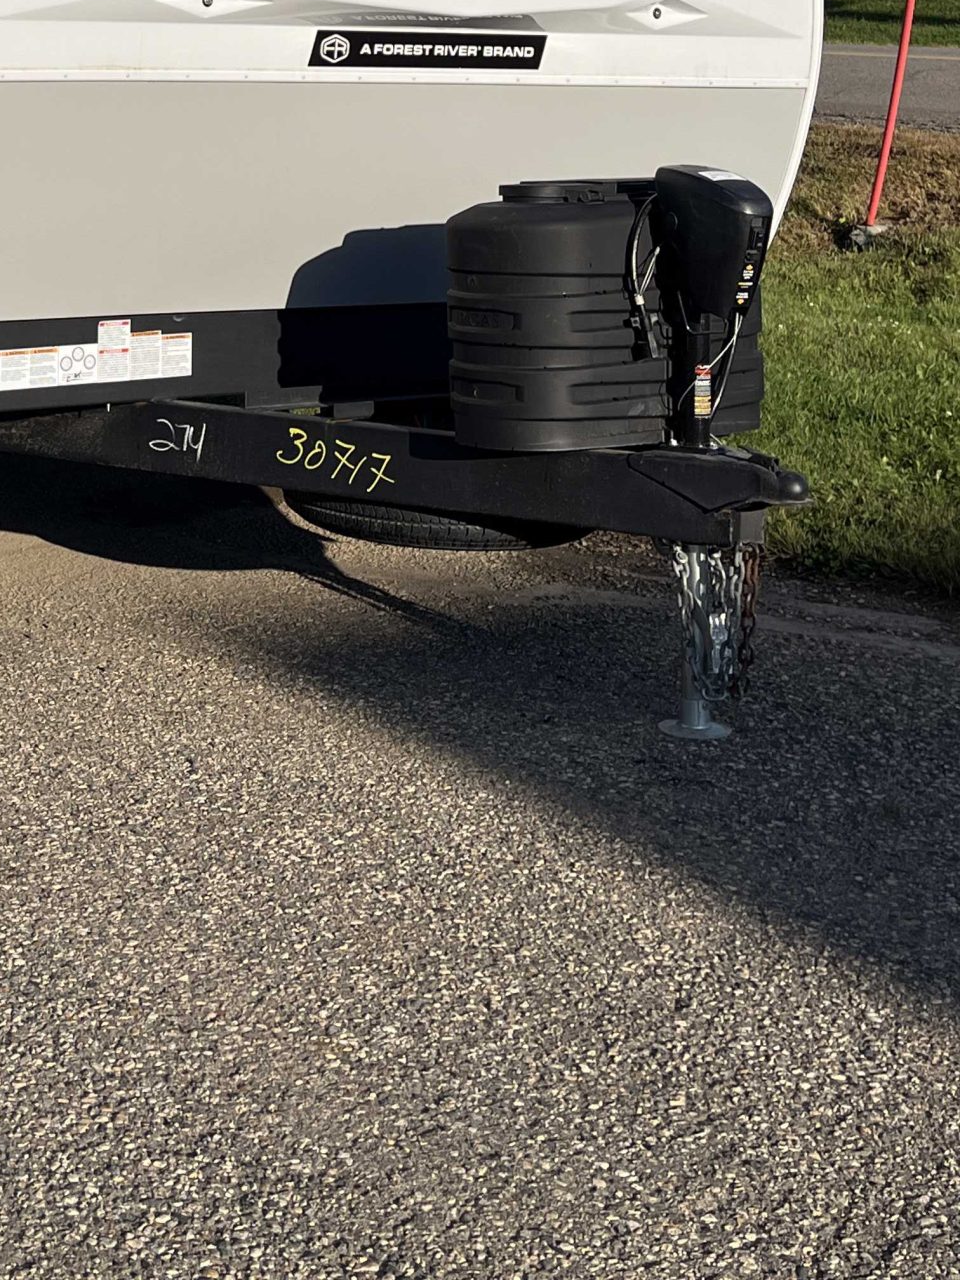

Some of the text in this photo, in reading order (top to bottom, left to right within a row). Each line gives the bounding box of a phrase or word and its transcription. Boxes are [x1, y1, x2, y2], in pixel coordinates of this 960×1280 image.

[359, 44, 372, 55] A
[374, 44, 433, 56] FOREST
[486, 46, 535, 58] BRAND
